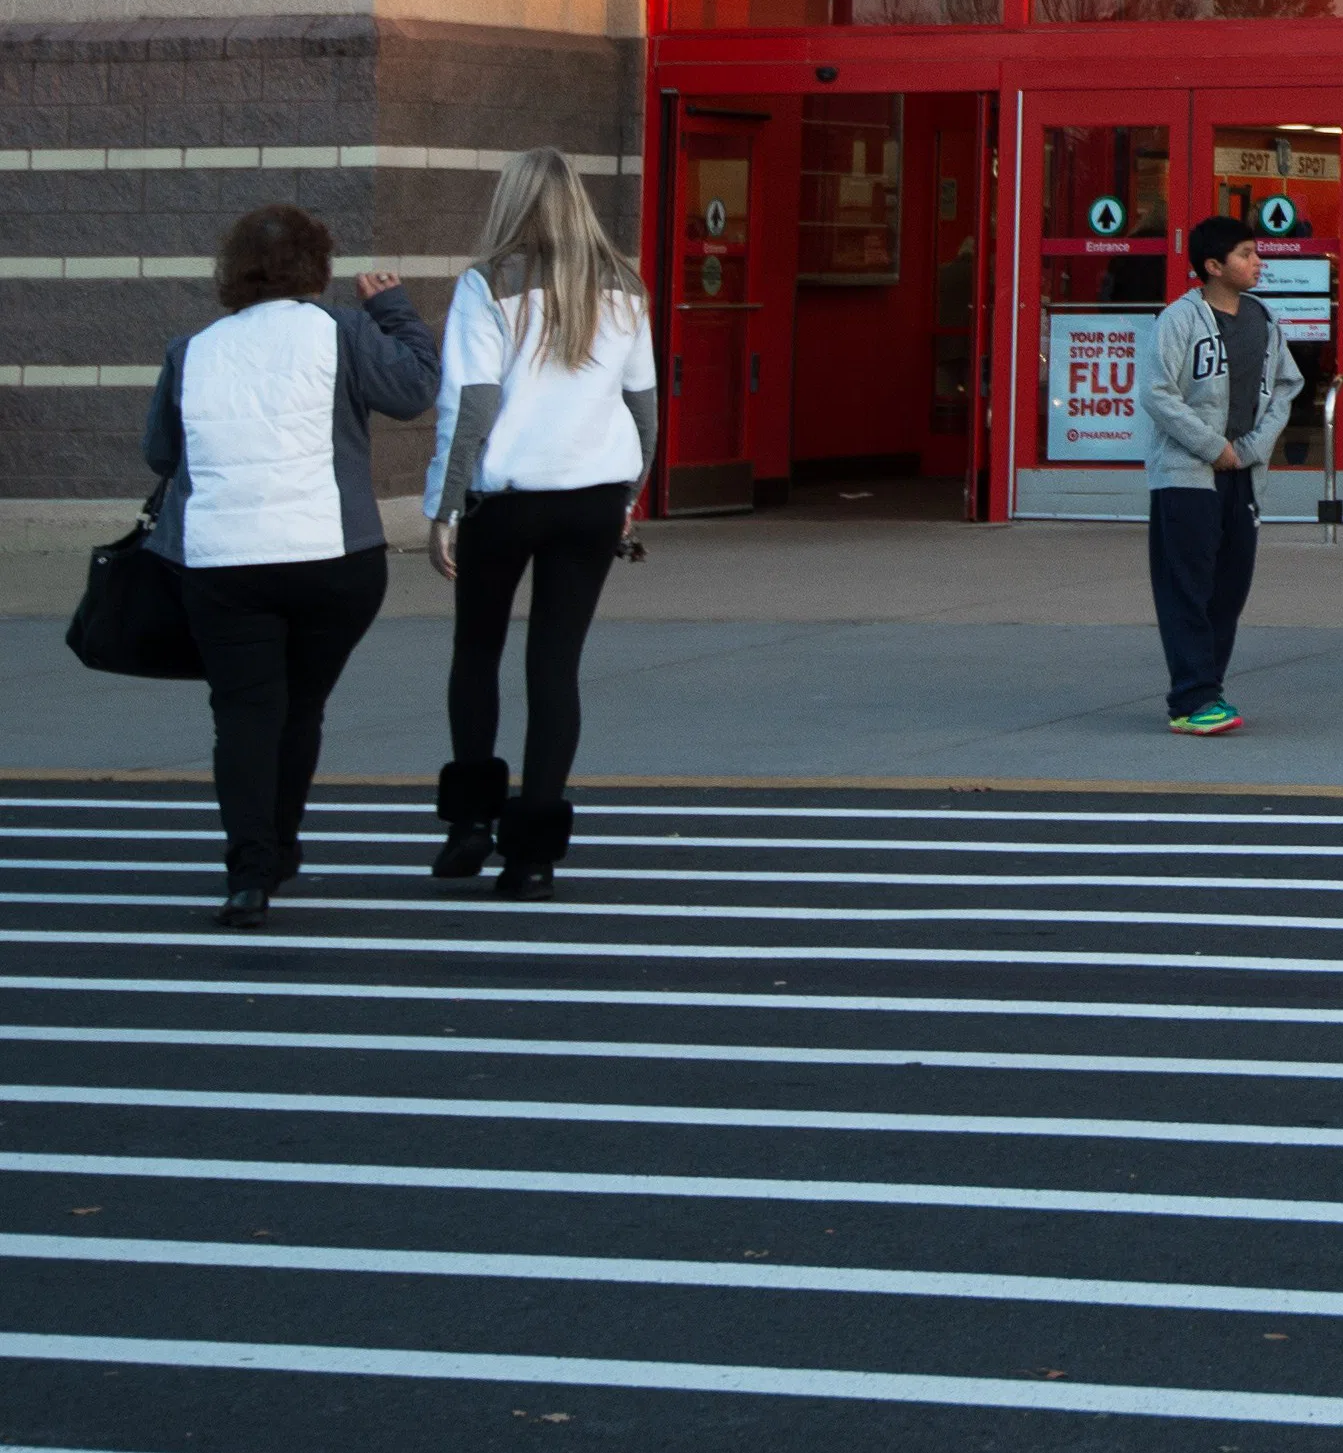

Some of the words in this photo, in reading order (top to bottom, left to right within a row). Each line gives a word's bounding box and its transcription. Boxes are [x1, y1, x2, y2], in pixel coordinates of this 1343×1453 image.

[1241, 152, 1270, 172] SPOT
[1298, 156, 1326, 175] SPOT
[1085, 241, 1130, 252] Entrance
[1257, 241, 1300, 251] Entrance
[1069, 331, 1104, 343] YOUR
[1108, 331, 1135, 343] ONE
[1069, 346, 1103, 358] STOP
[1108, 346, 1135, 358] FOR
[1069, 362, 1135, 394] FLU
[1068, 398, 1135, 417] SHOTS
[1080, 431, 1132, 440] PHARMACY
